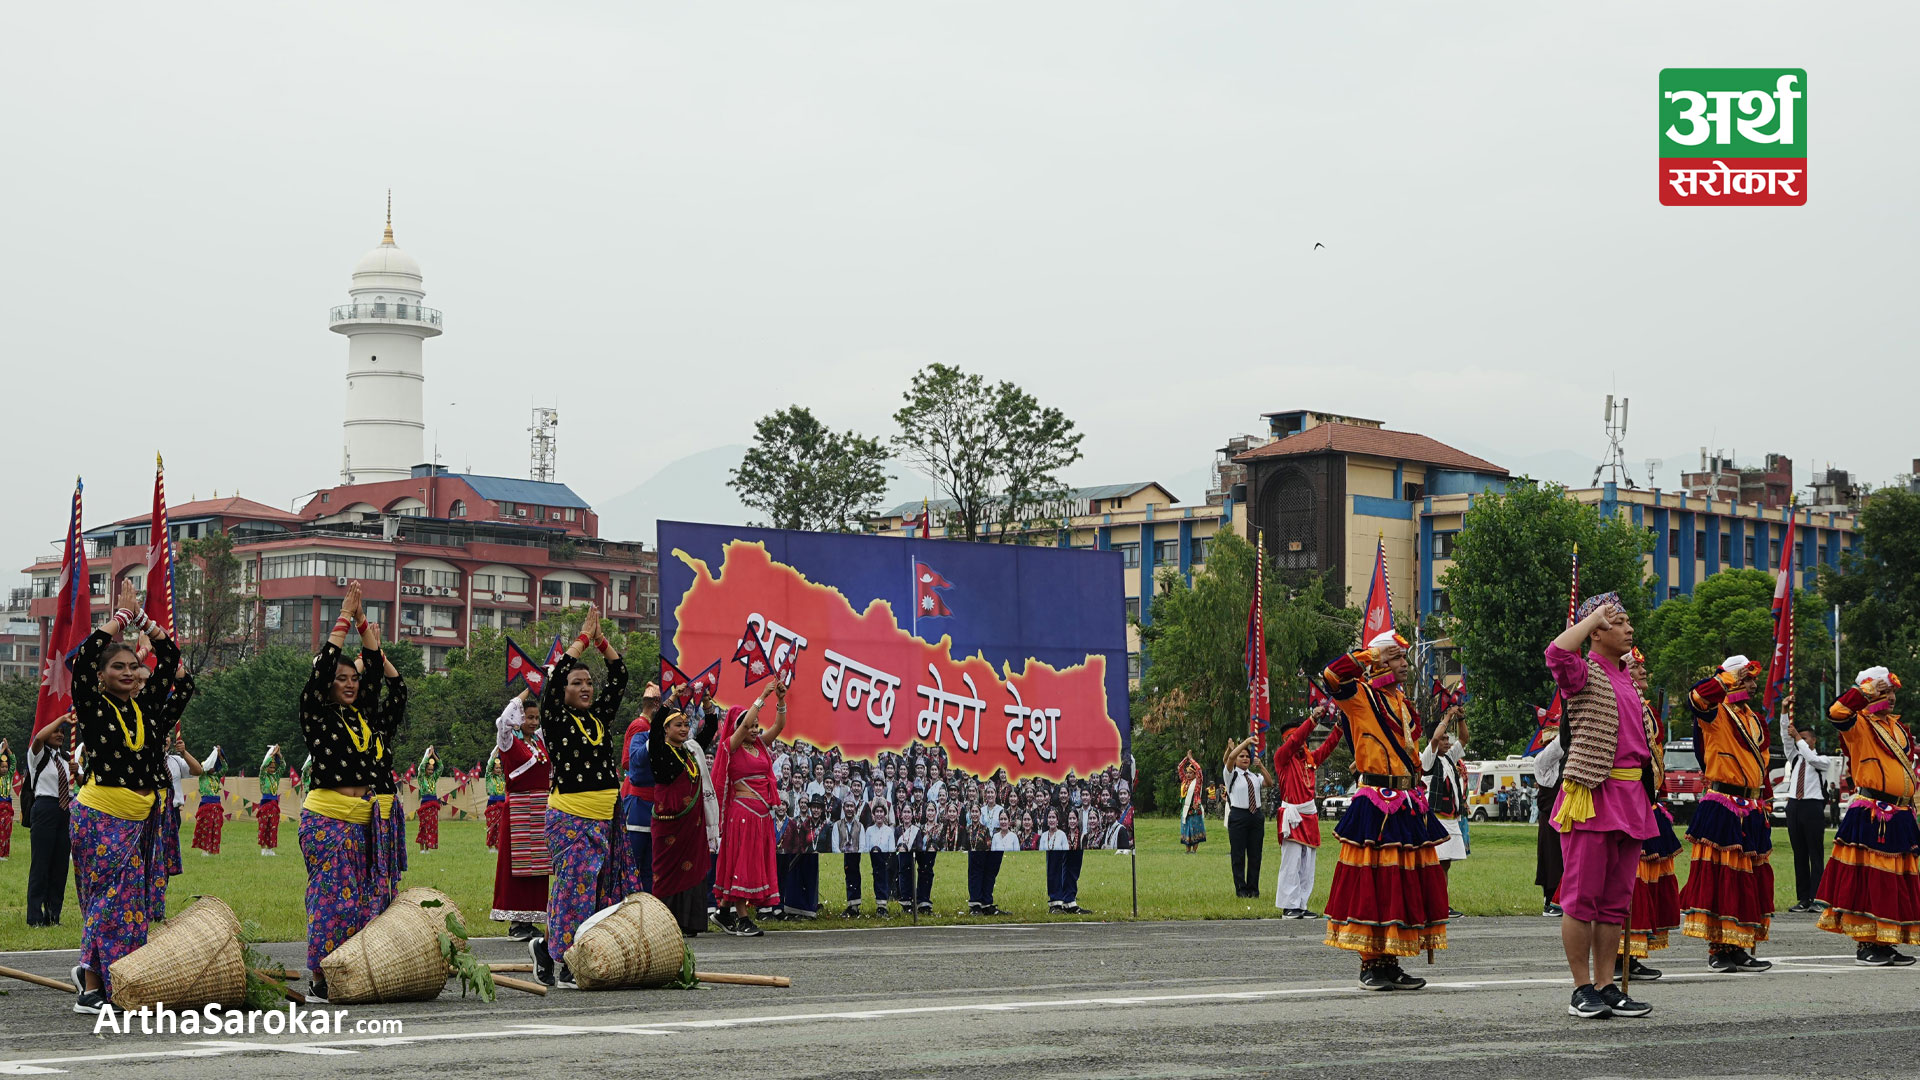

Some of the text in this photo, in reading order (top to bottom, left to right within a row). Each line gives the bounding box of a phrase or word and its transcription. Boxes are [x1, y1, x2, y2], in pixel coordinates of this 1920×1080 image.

[1013, 498, 1090, 522] CORPORATION
[821, 648, 901, 736] बन्छ
[916, 662, 987, 752] मेरो
[1003, 680, 1061, 763] देश
